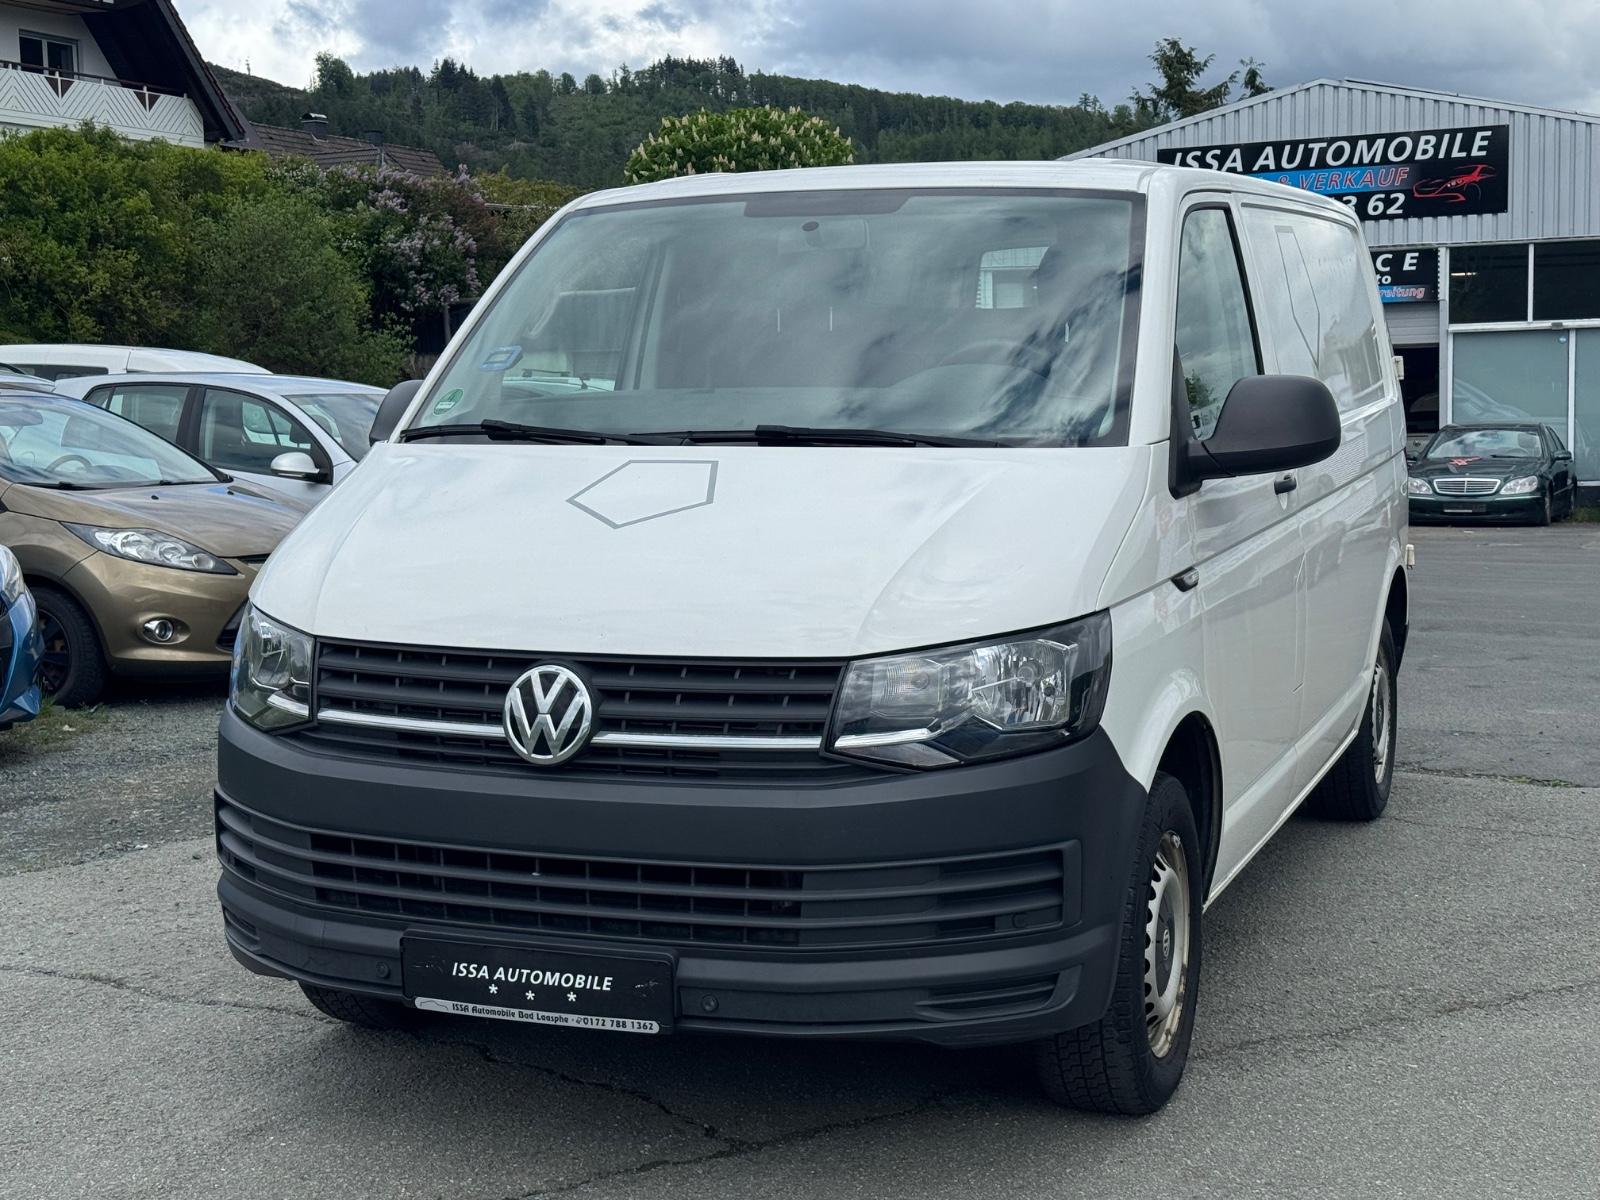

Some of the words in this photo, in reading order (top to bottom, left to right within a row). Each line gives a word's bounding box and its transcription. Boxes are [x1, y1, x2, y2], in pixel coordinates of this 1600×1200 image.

[1174, 148, 1243, 171] ISSA
[1252, 130, 1493, 171] AUTOMOBILE
[1300, 168, 1409, 191] VERKAUF
[1367, 192, 1406, 216] 62
[1375, 252, 1419, 272] CE
[1376, 274, 1392, 285] to
[1378, 287, 1425, 299] reitung
[505, 665, 592, 764] VW
[452, 962, 489, 980] ISSA
[493, 967, 613, 991] AUTOMOBILE
[452, 1003, 470, 1012] ISSA
[471, 1006, 516, 1018] Automobile
[518, 1011, 534, 1020] Bad
[536, 1013, 569, 1023] Laasphe
[582, 1018, 606, 1027] 0172
[609, 1019, 627, 1029] 788
[630, 1021, 654, 1031] 1362
